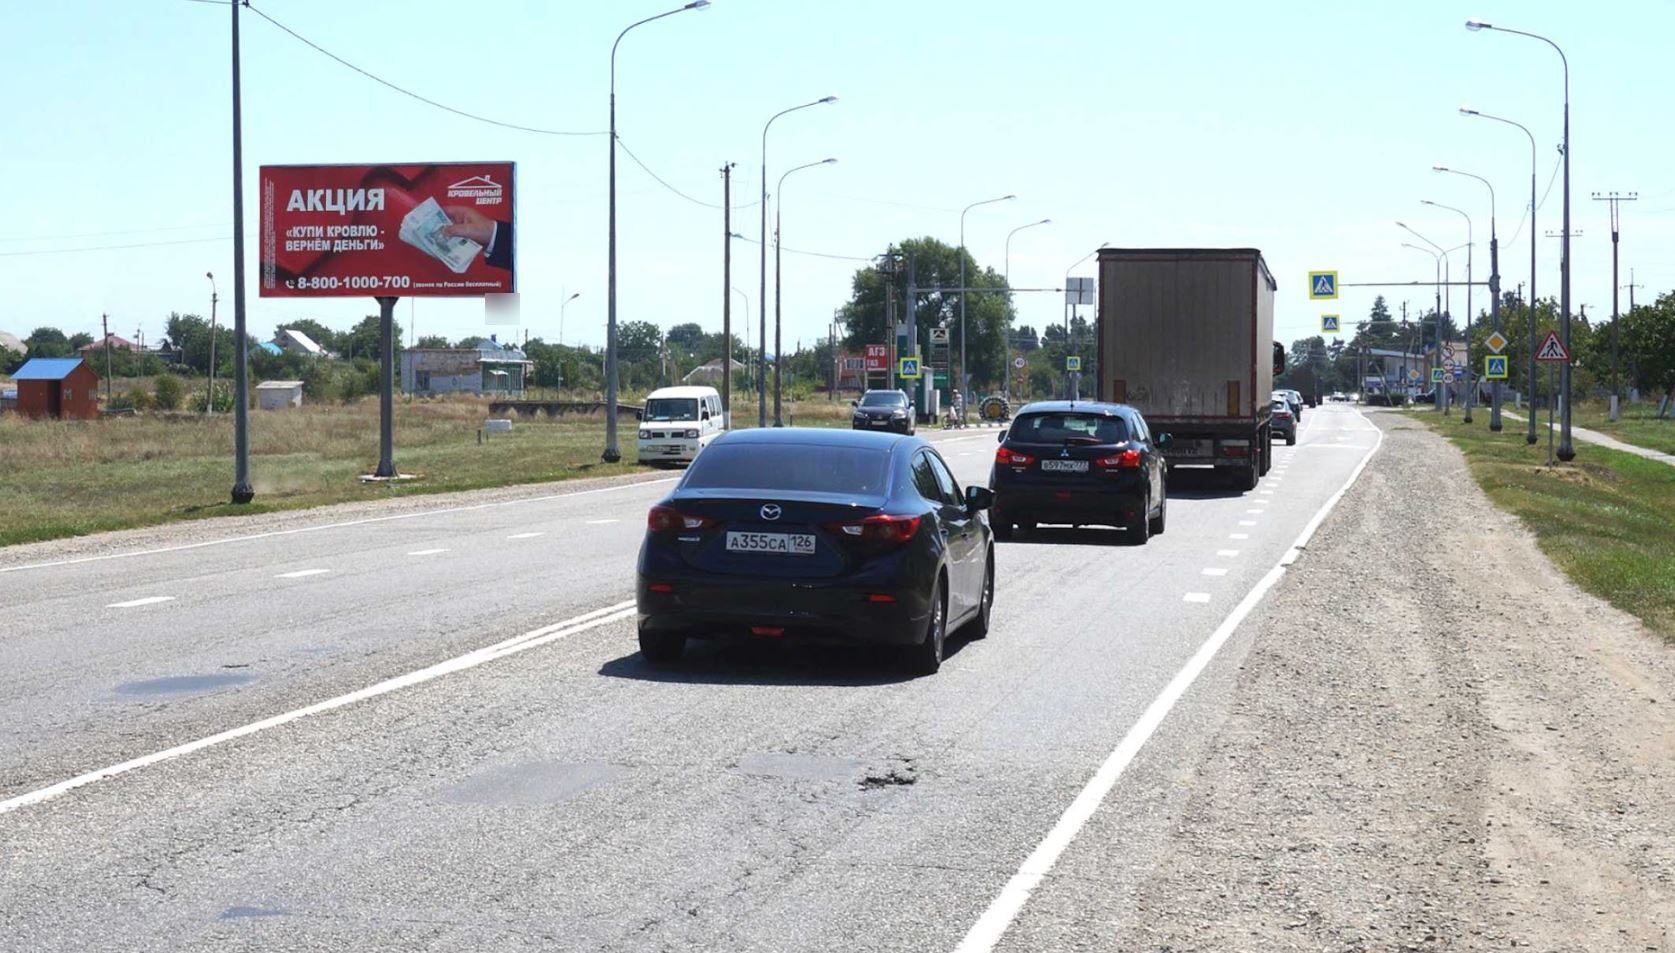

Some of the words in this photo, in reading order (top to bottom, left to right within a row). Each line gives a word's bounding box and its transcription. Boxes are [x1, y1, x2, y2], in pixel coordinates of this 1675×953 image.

[447, 188, 503, 198] КРОВЕЛЬНЫЙ
[286, 188, 385, 215] АКЦИЯ
[475, 197, 503, 205] ЦЕНТР
[286, 225, 324, 238] «КУПИ
[327, 225, 378, 237] КРОВЛЮ
[285, 238, 331, 251] ВЕРНЁМ
[333, 239, 385, 253] ДЕНЬГИ»
[297, 276, 411, 289] 8-800-1000-700
[443, 280, 464, 288] России
[730, 534, 786, 550] А355СА
[790, 535, 812, 548] 126
